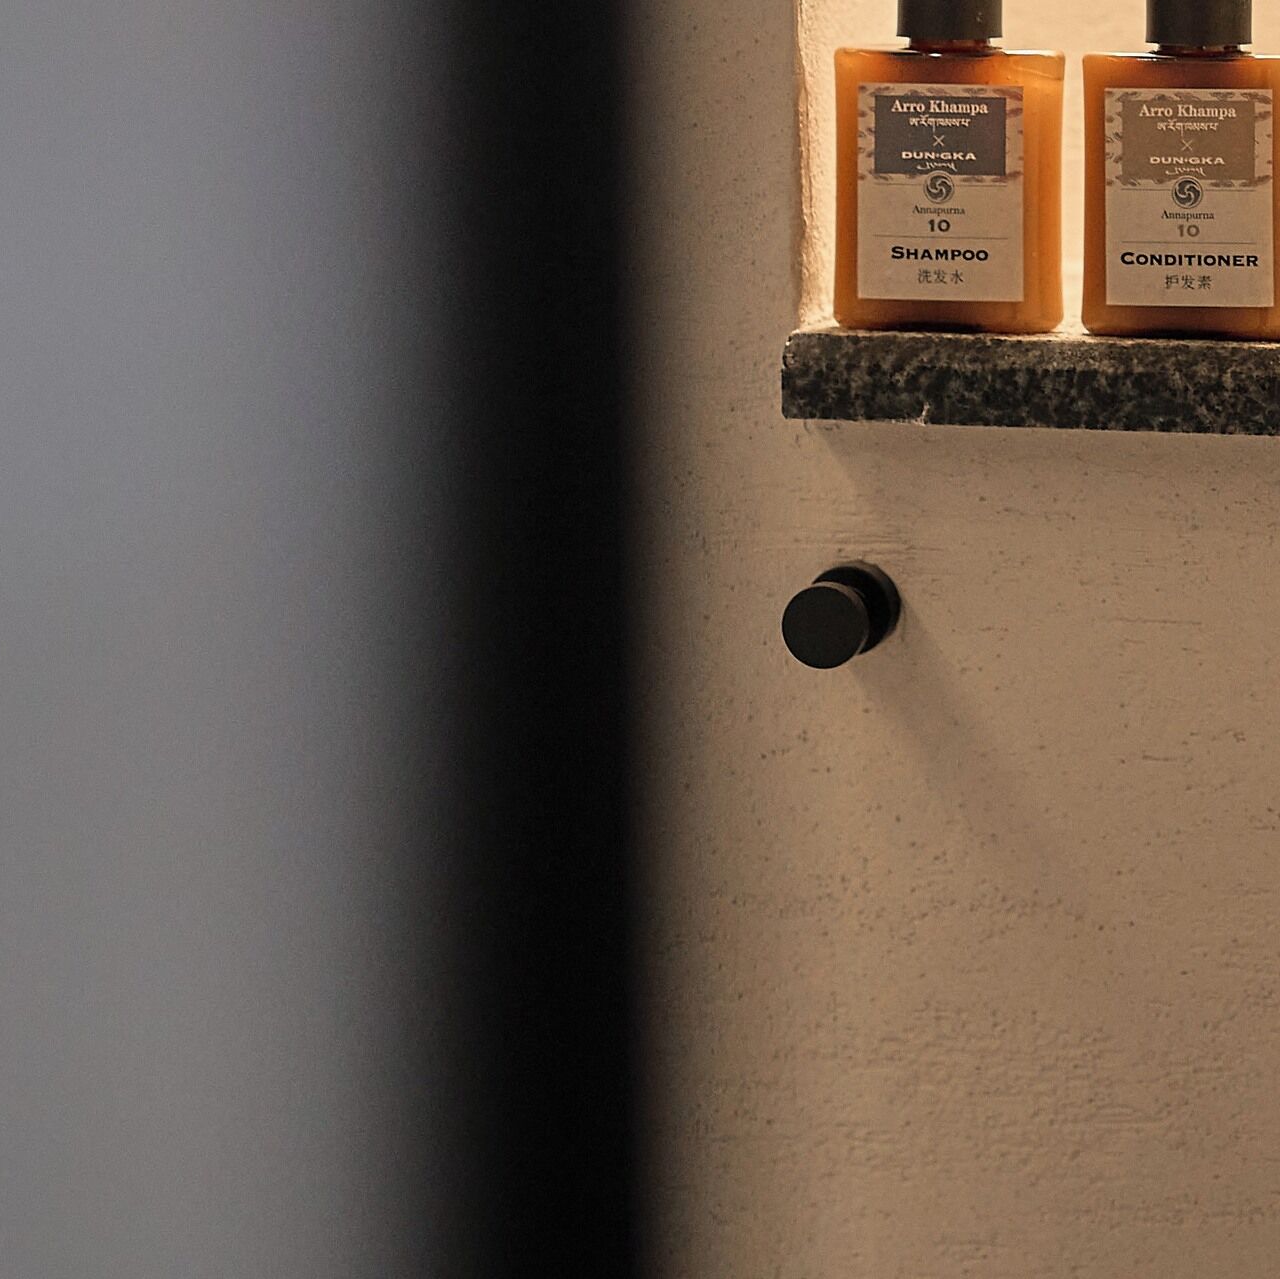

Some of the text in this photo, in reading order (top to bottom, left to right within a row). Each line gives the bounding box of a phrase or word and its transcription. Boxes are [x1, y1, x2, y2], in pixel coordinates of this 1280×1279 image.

[891, 100, 988, 116] Arro Khampa
[1139, 104, 1236, 120] Arro Khampa
[912, 205, 965, 216] Annapurna
[1161, 210, 1215, 221] Annapurna
[928, 219, 950, 232] 10
[1177, 224, 1200, 237] 10
[891, 246, 989, 261] SHAMPOO
[1120, 252, 1258, 267] CONDITIONER
[918, 269, 964, 284] 洗发水
[1165, 274, 1212, 290] 护发素
